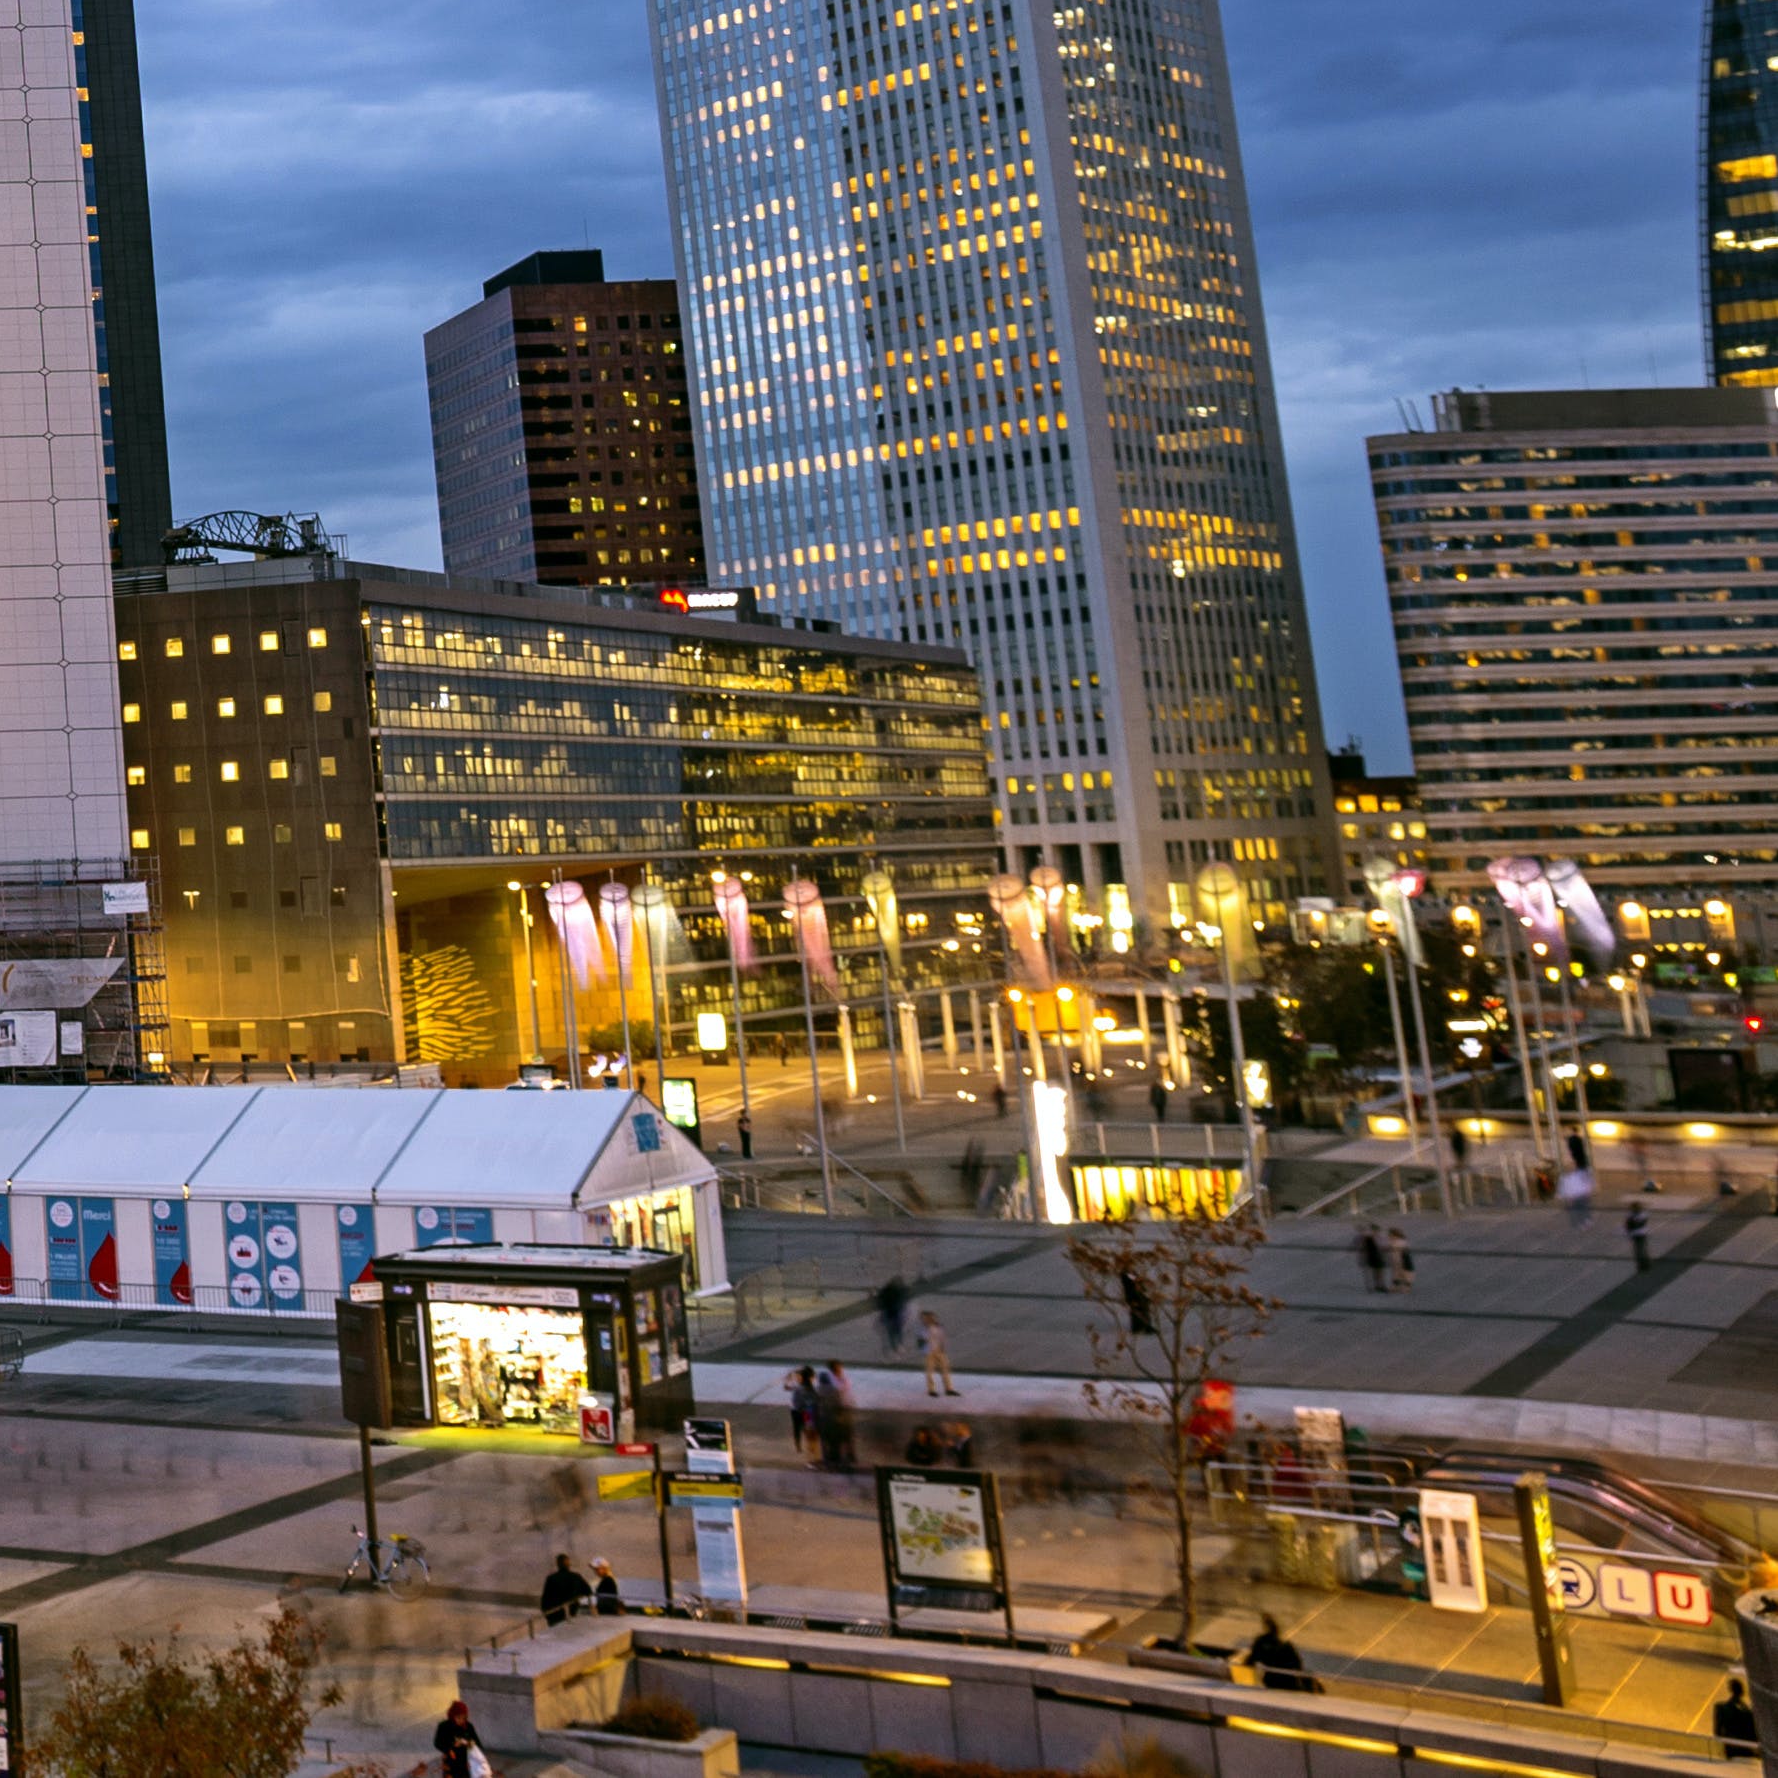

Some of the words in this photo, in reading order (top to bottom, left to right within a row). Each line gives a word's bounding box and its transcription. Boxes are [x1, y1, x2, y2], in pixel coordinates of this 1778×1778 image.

[83, 1209, 111, 1221] Merci
[1617, 1577, 1635, 1603] L
[1670, 1584, 1693, 1611] U
